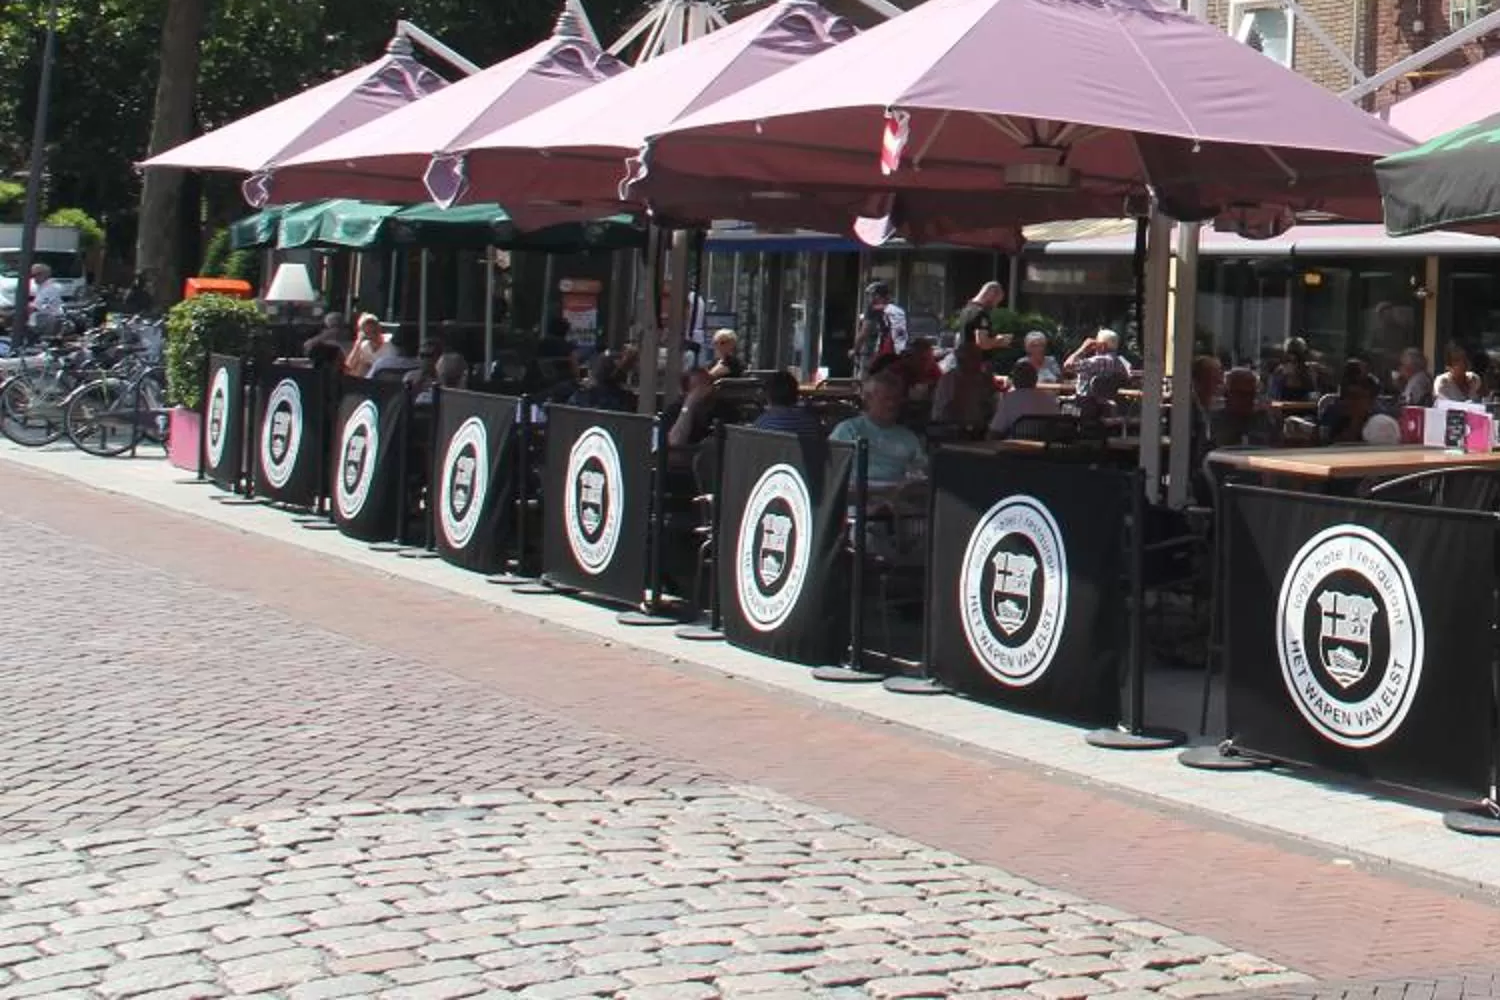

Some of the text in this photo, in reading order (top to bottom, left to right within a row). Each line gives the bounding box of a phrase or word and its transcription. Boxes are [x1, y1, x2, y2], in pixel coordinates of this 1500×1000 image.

[1357, 551, 1404, 625] restaurant
[1291, 639, 1405, 727] HET WAPEN VAN ELST
